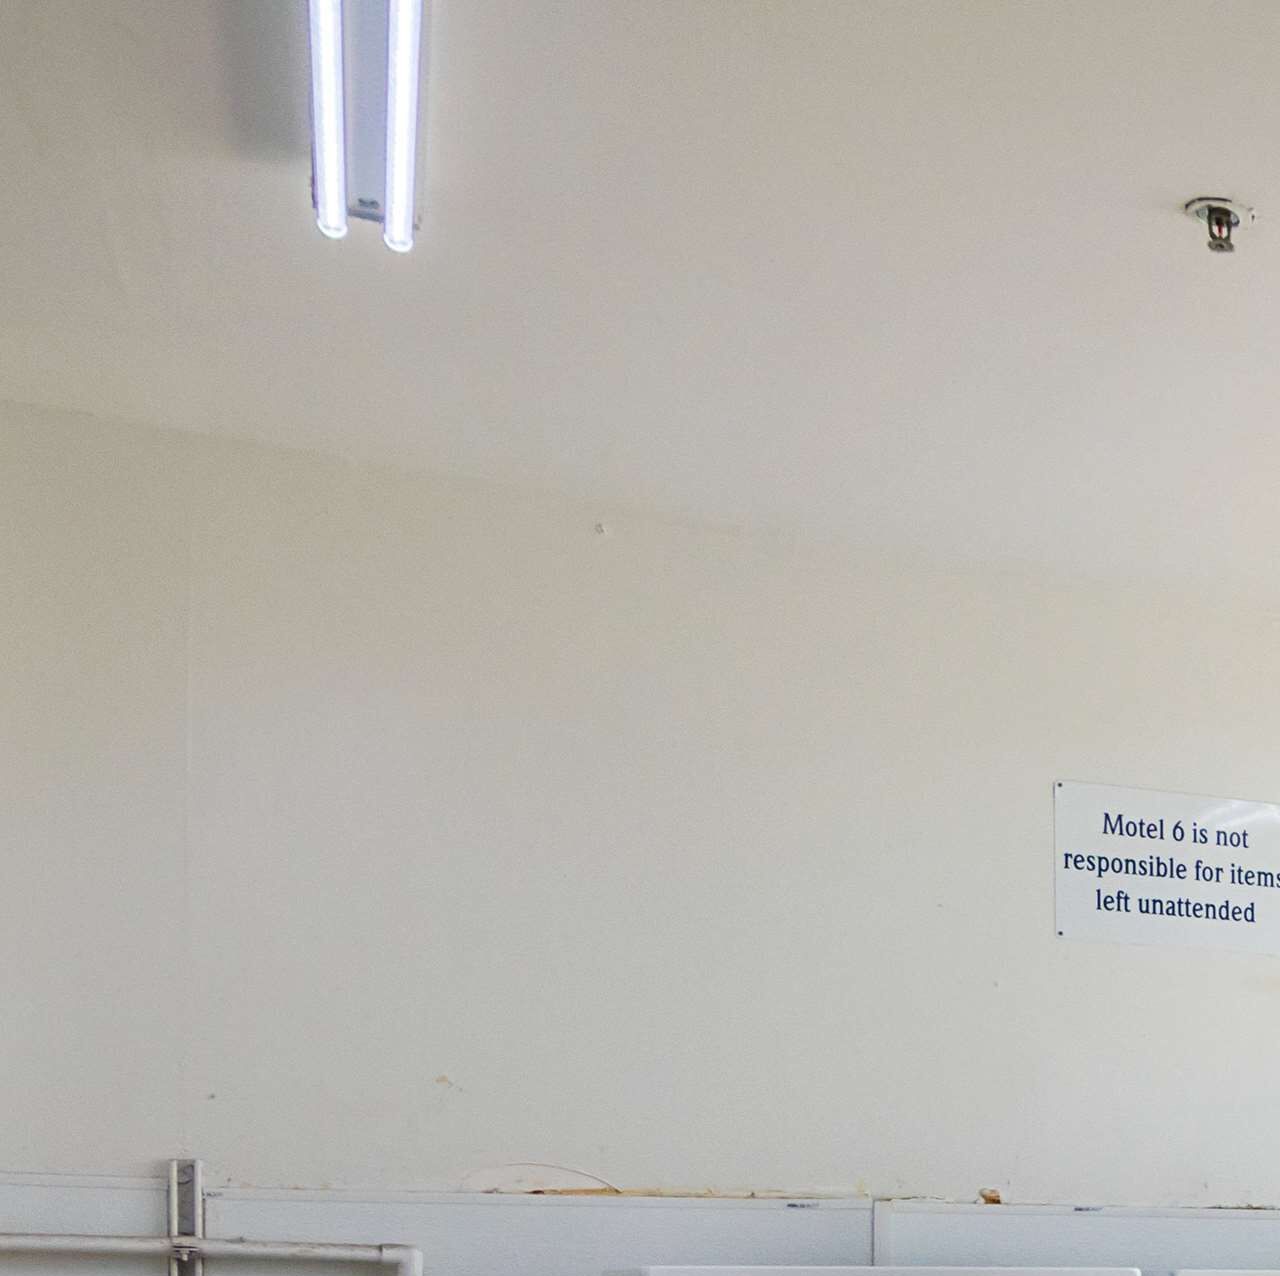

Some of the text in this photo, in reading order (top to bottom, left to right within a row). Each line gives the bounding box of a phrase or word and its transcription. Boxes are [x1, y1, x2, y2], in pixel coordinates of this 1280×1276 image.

[1102, 812, 1249, 849] Motel 6 is not
[1063, 852, 1187, 880] responsible
[1195, 859, 1223, 883] for
[1096, 889, 1256, 923] left unattended
